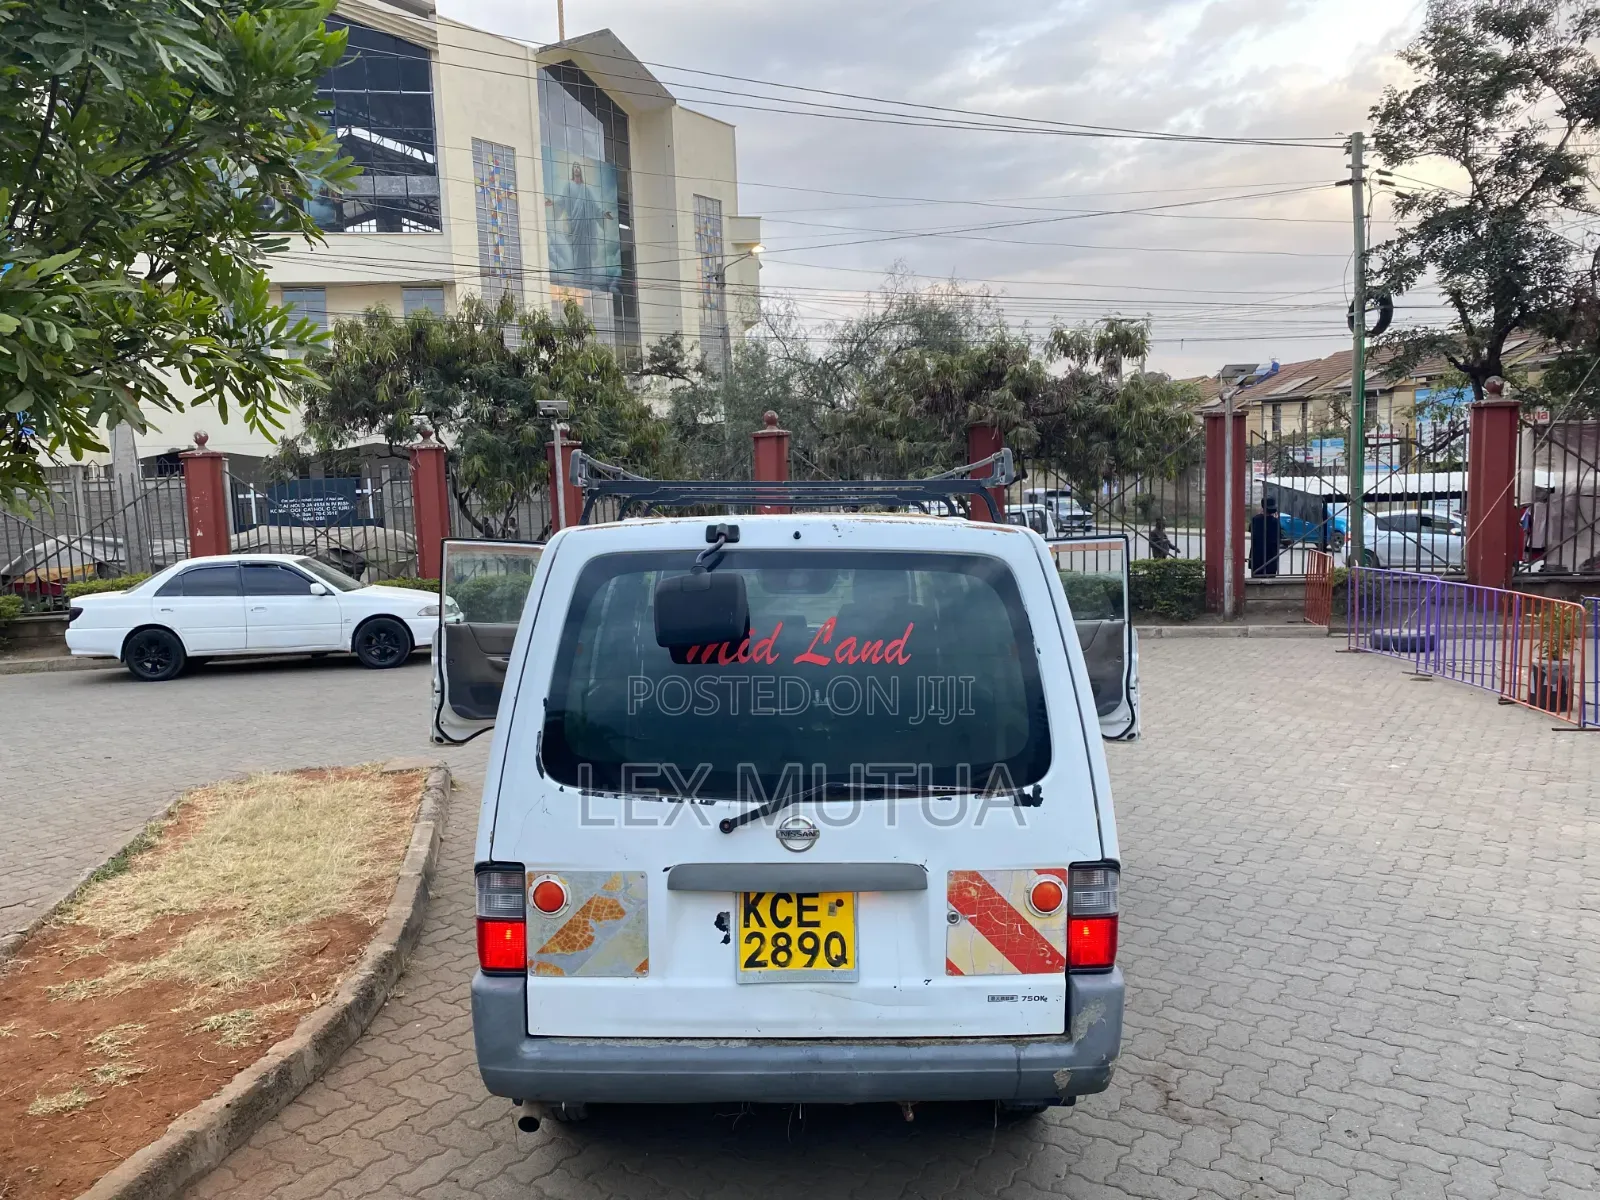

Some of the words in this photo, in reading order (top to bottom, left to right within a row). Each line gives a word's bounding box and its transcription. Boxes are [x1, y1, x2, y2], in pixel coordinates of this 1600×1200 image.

[793, 616, 914, 667] Land
[743, 892, 821, 929] KCE
[743, 931, 848, 969] 289Q
